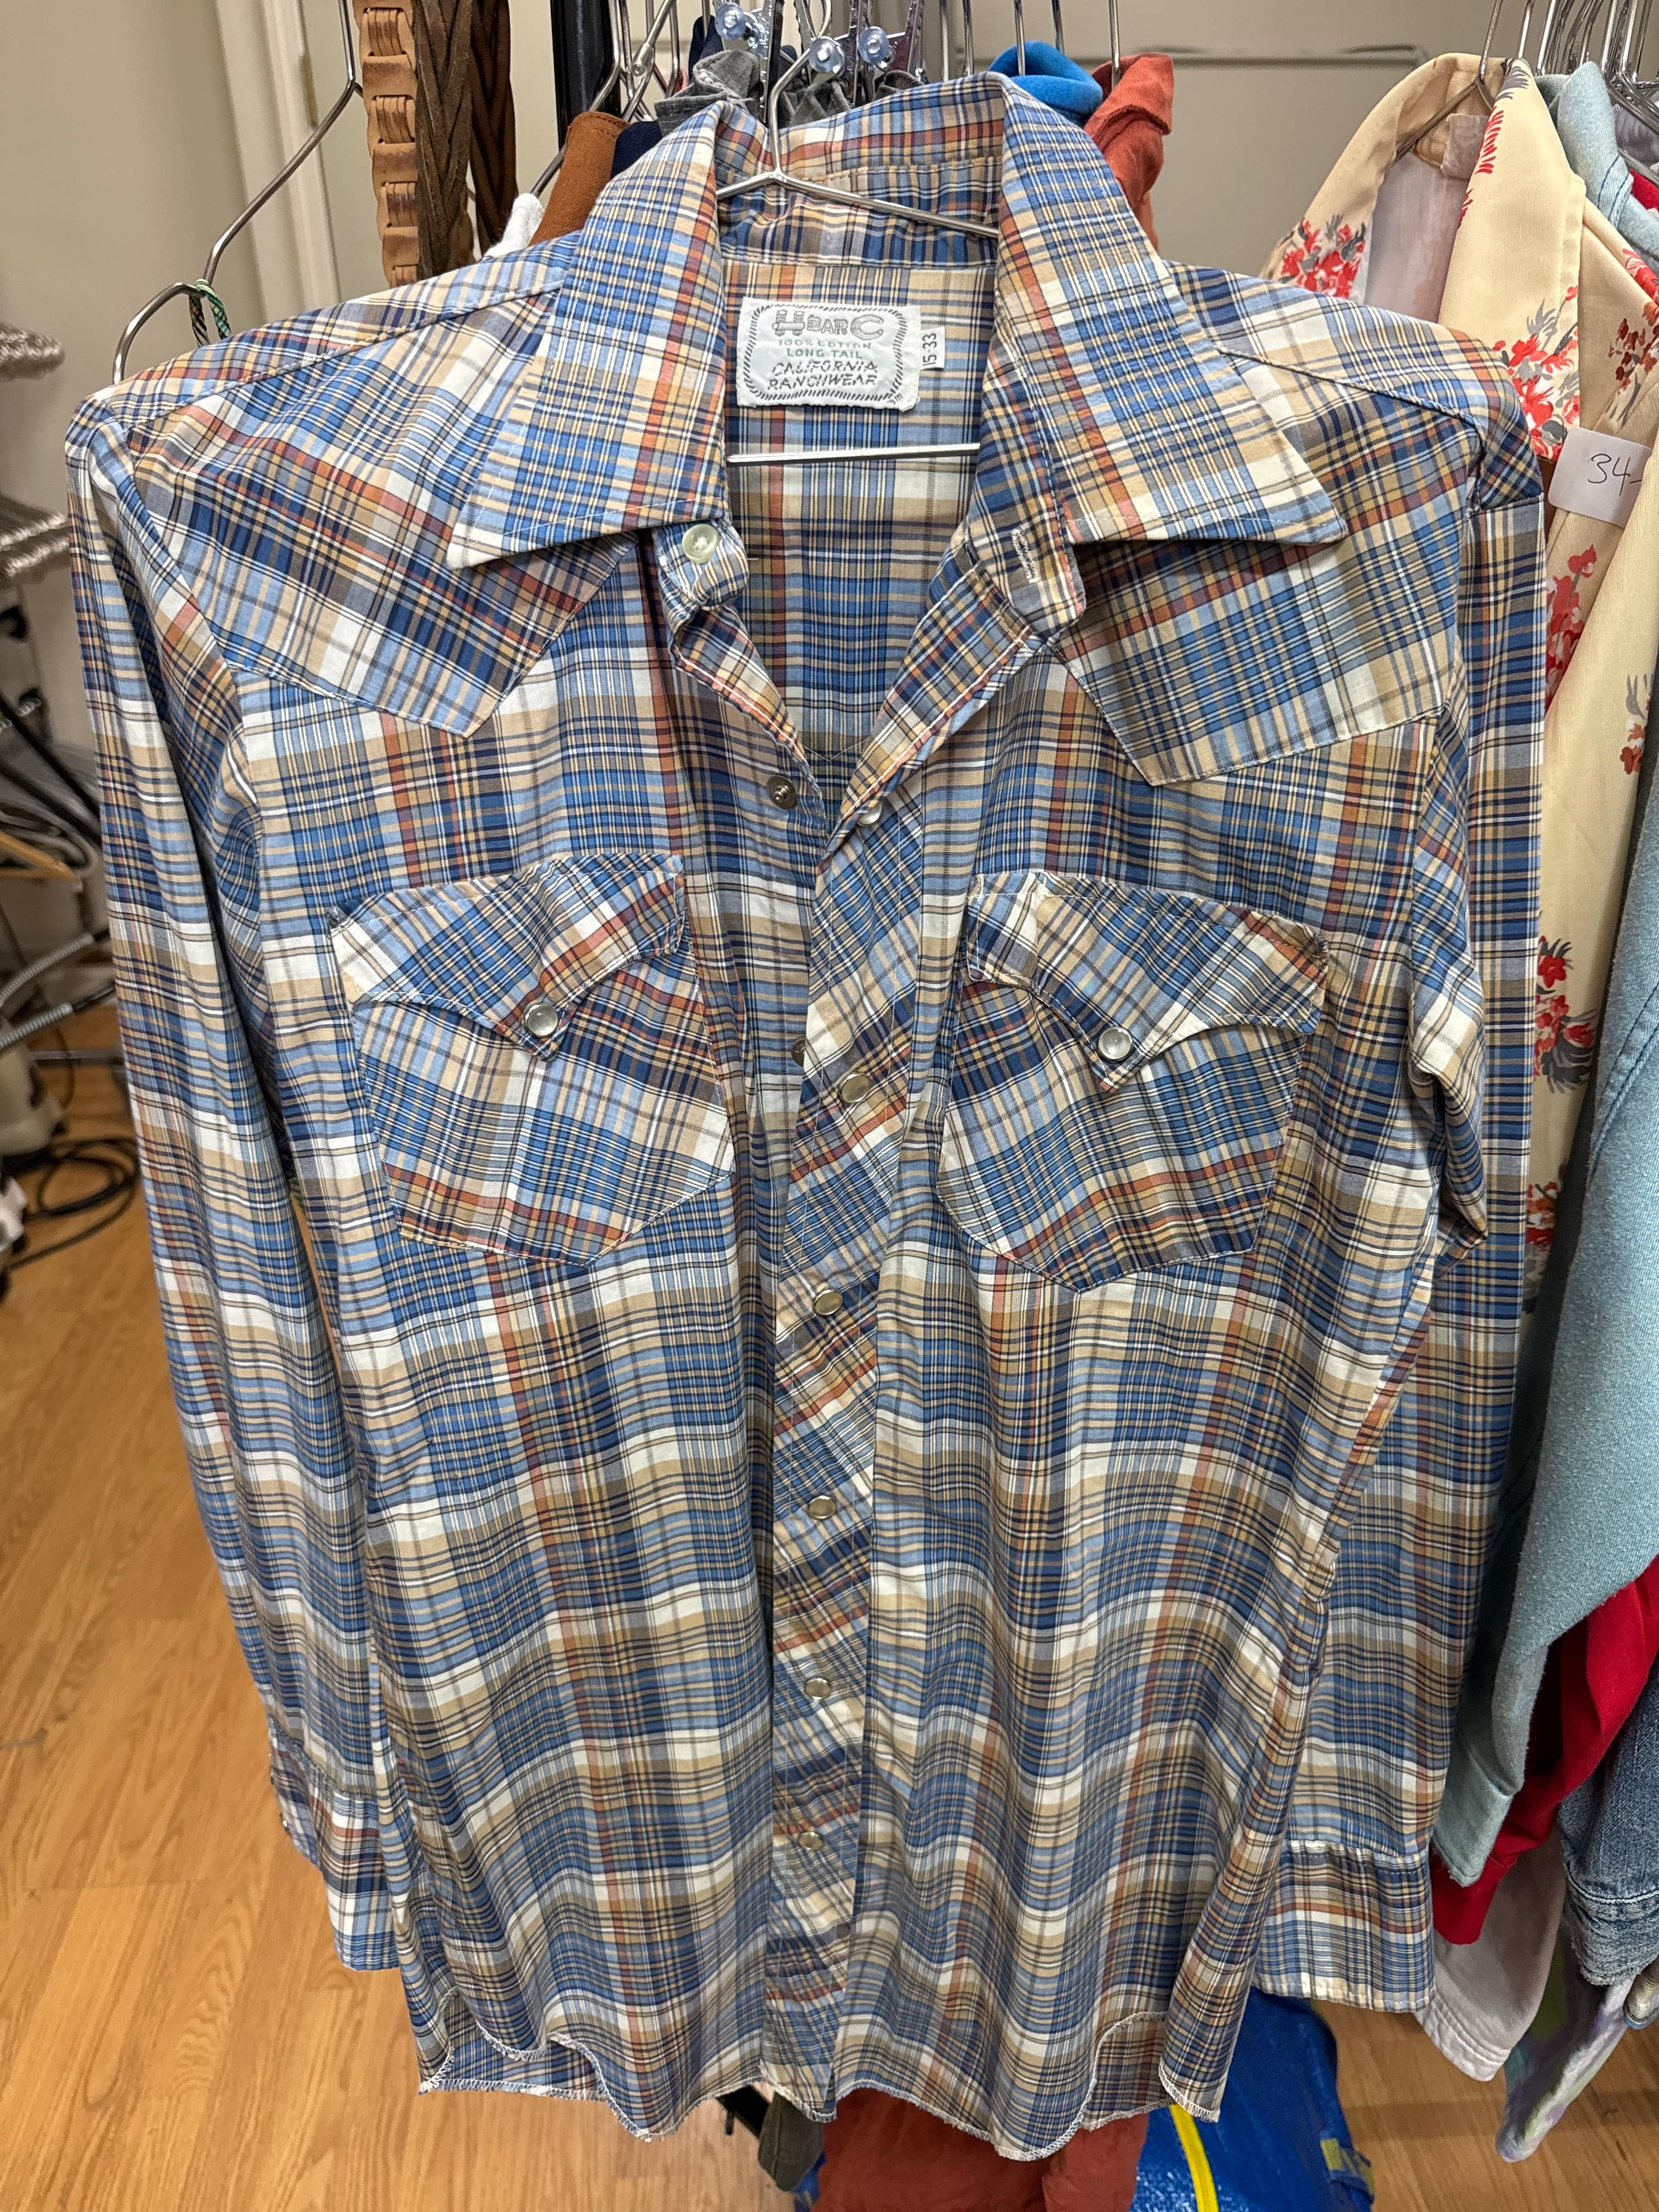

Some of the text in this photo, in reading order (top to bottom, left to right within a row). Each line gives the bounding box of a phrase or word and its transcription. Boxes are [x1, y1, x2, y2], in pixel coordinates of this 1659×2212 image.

[817, 341, 872, 349] COTTON
[787, 348, 863, 359] LONG TAIL
[772, 360, 878, 376] CALIFORNIA
[768, 374, 878, 391] RANCHWEAR
